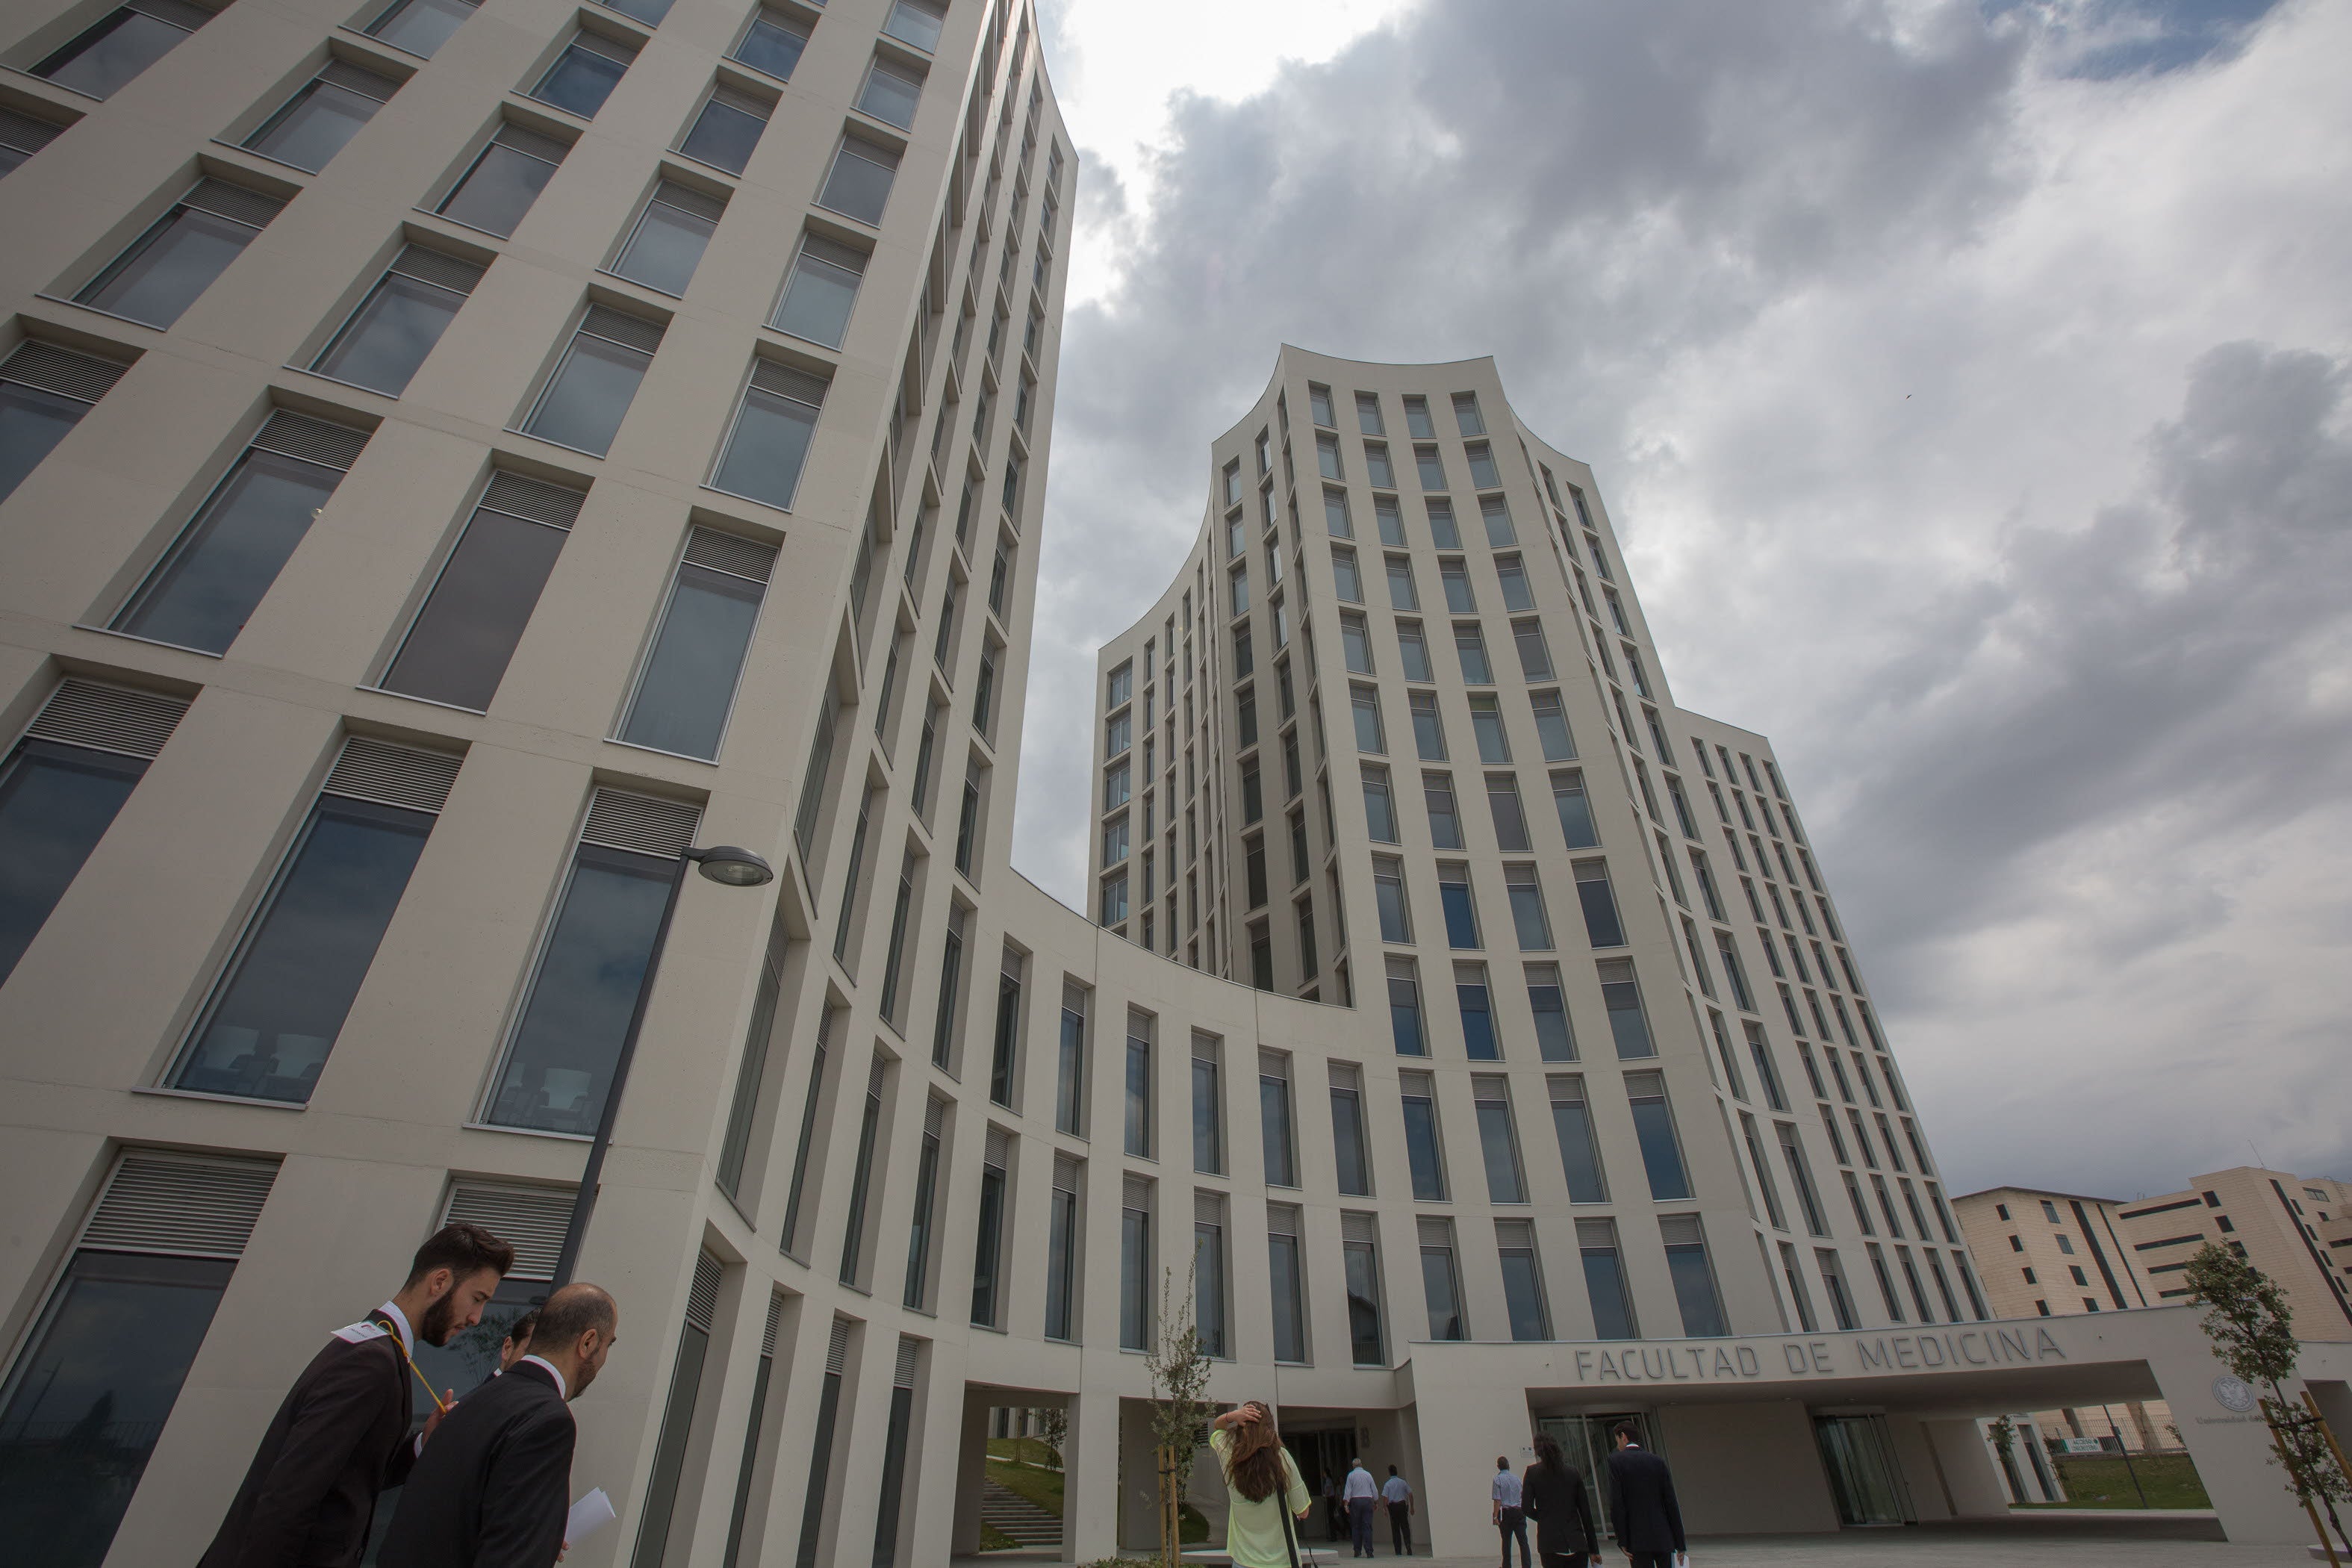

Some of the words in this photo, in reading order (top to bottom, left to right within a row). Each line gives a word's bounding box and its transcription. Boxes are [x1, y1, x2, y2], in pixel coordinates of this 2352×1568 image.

[1575, 1347, 1760, 1380] FACULTAD
[1783, 1343, 1833, 1374] DE
[1856, 1326, 2066, 1369] MEDICINA
